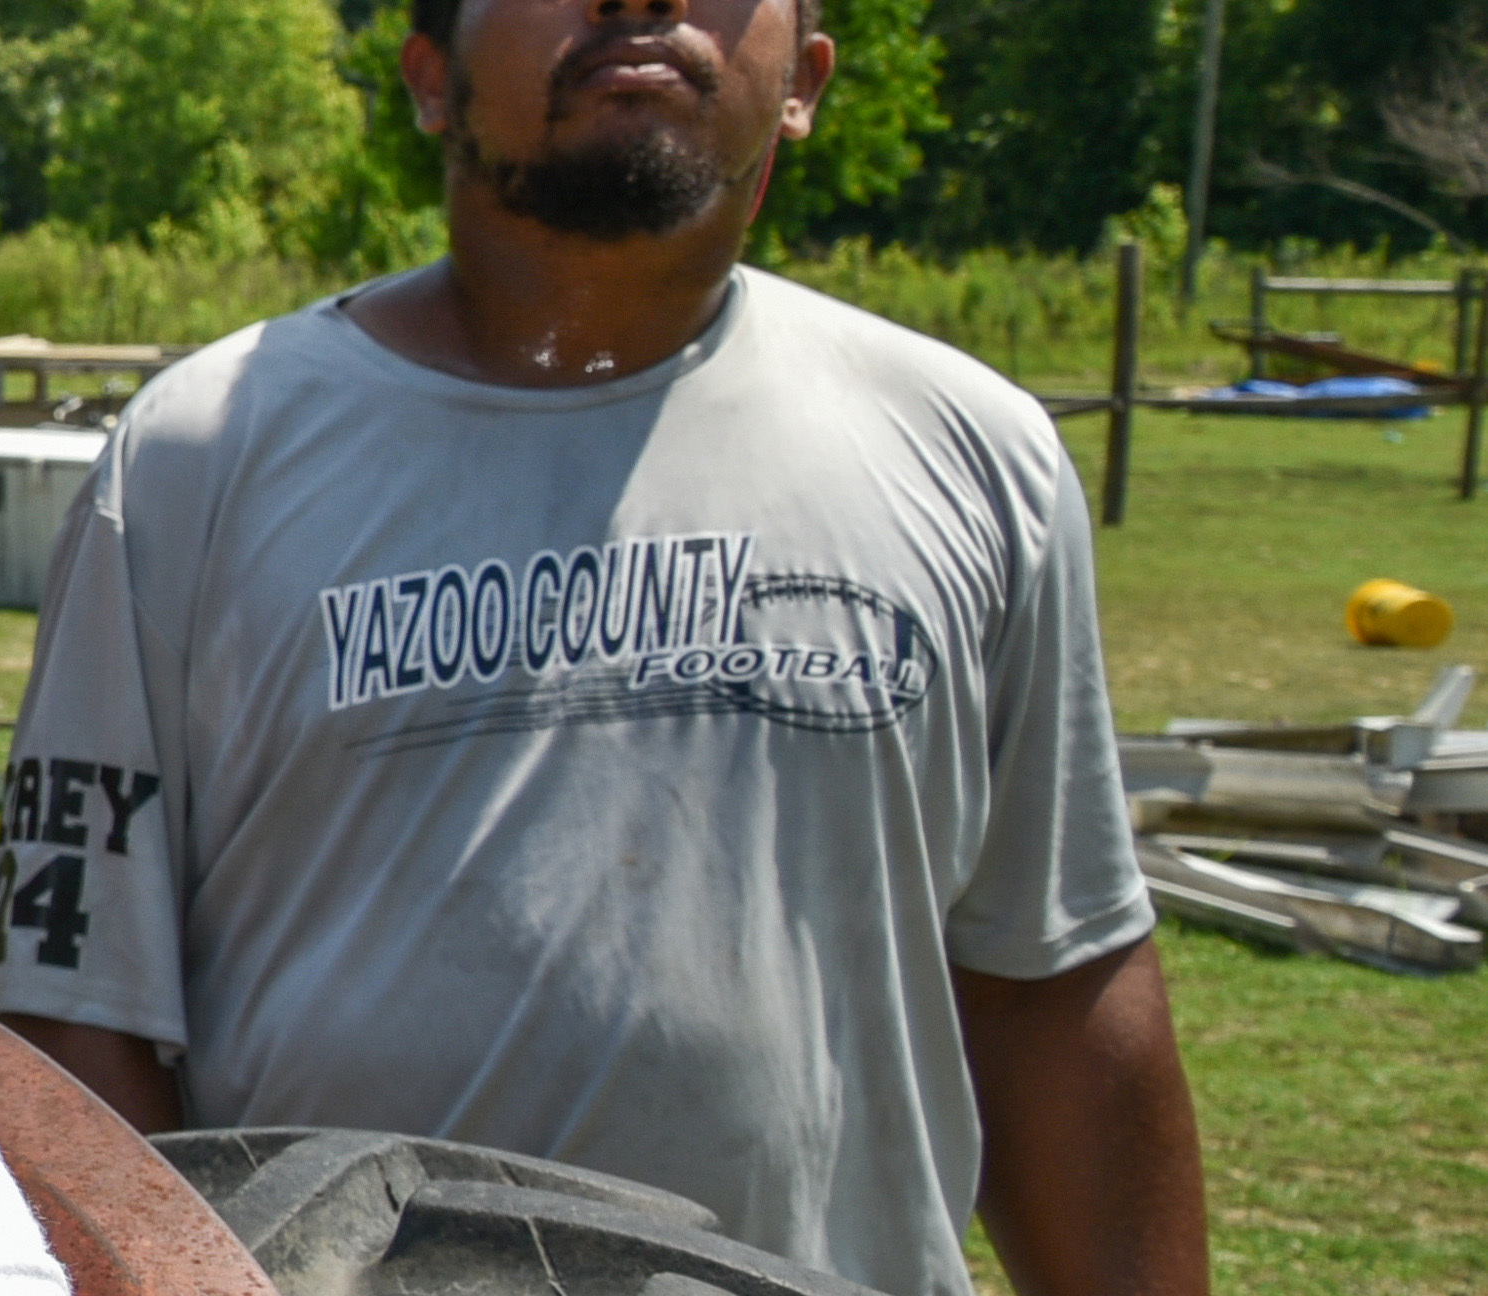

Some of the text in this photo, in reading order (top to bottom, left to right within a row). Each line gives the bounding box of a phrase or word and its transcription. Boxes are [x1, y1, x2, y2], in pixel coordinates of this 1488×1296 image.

[320, 531, 758, 711] YAZOO COUNTY
[632, 641, 929, 698] FOOTBALL
